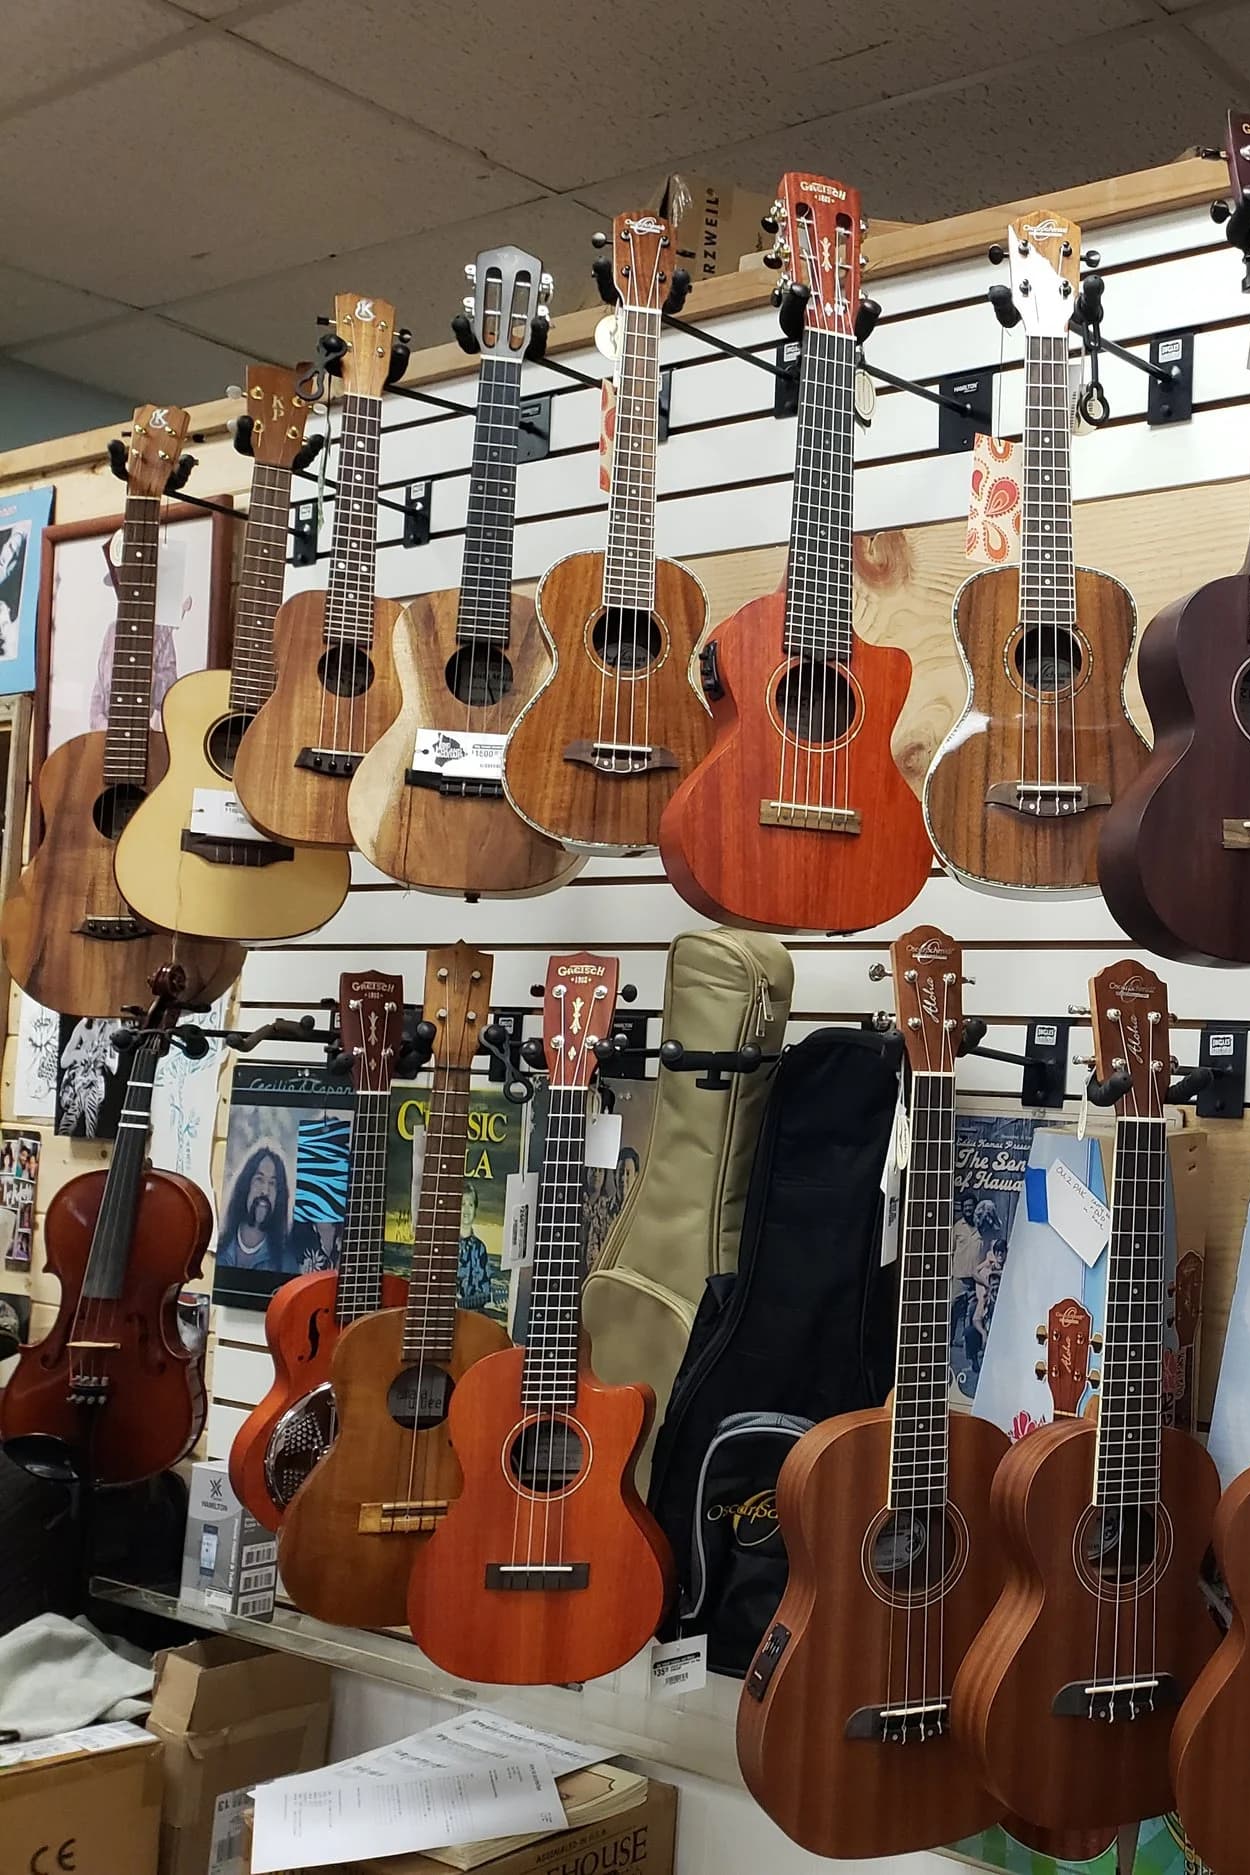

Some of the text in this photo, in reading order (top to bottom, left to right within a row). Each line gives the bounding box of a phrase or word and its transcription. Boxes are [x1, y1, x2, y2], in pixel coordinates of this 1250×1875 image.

[272, 395, 284, 409] K
[272, 409, 285, 422] P
[923, 976, 940, 1024] Aloha
[1126, 1014, 1144, 1065] Aloha
[312, 1080, 356, 1095] Kapon
[397, 1100, 507, 1143] CSIC
[956, 1147, 989, 1169] The
[973, 1170, 1024, 1192] Hawa
[706, 1502, 779, 1522] OscarSc
